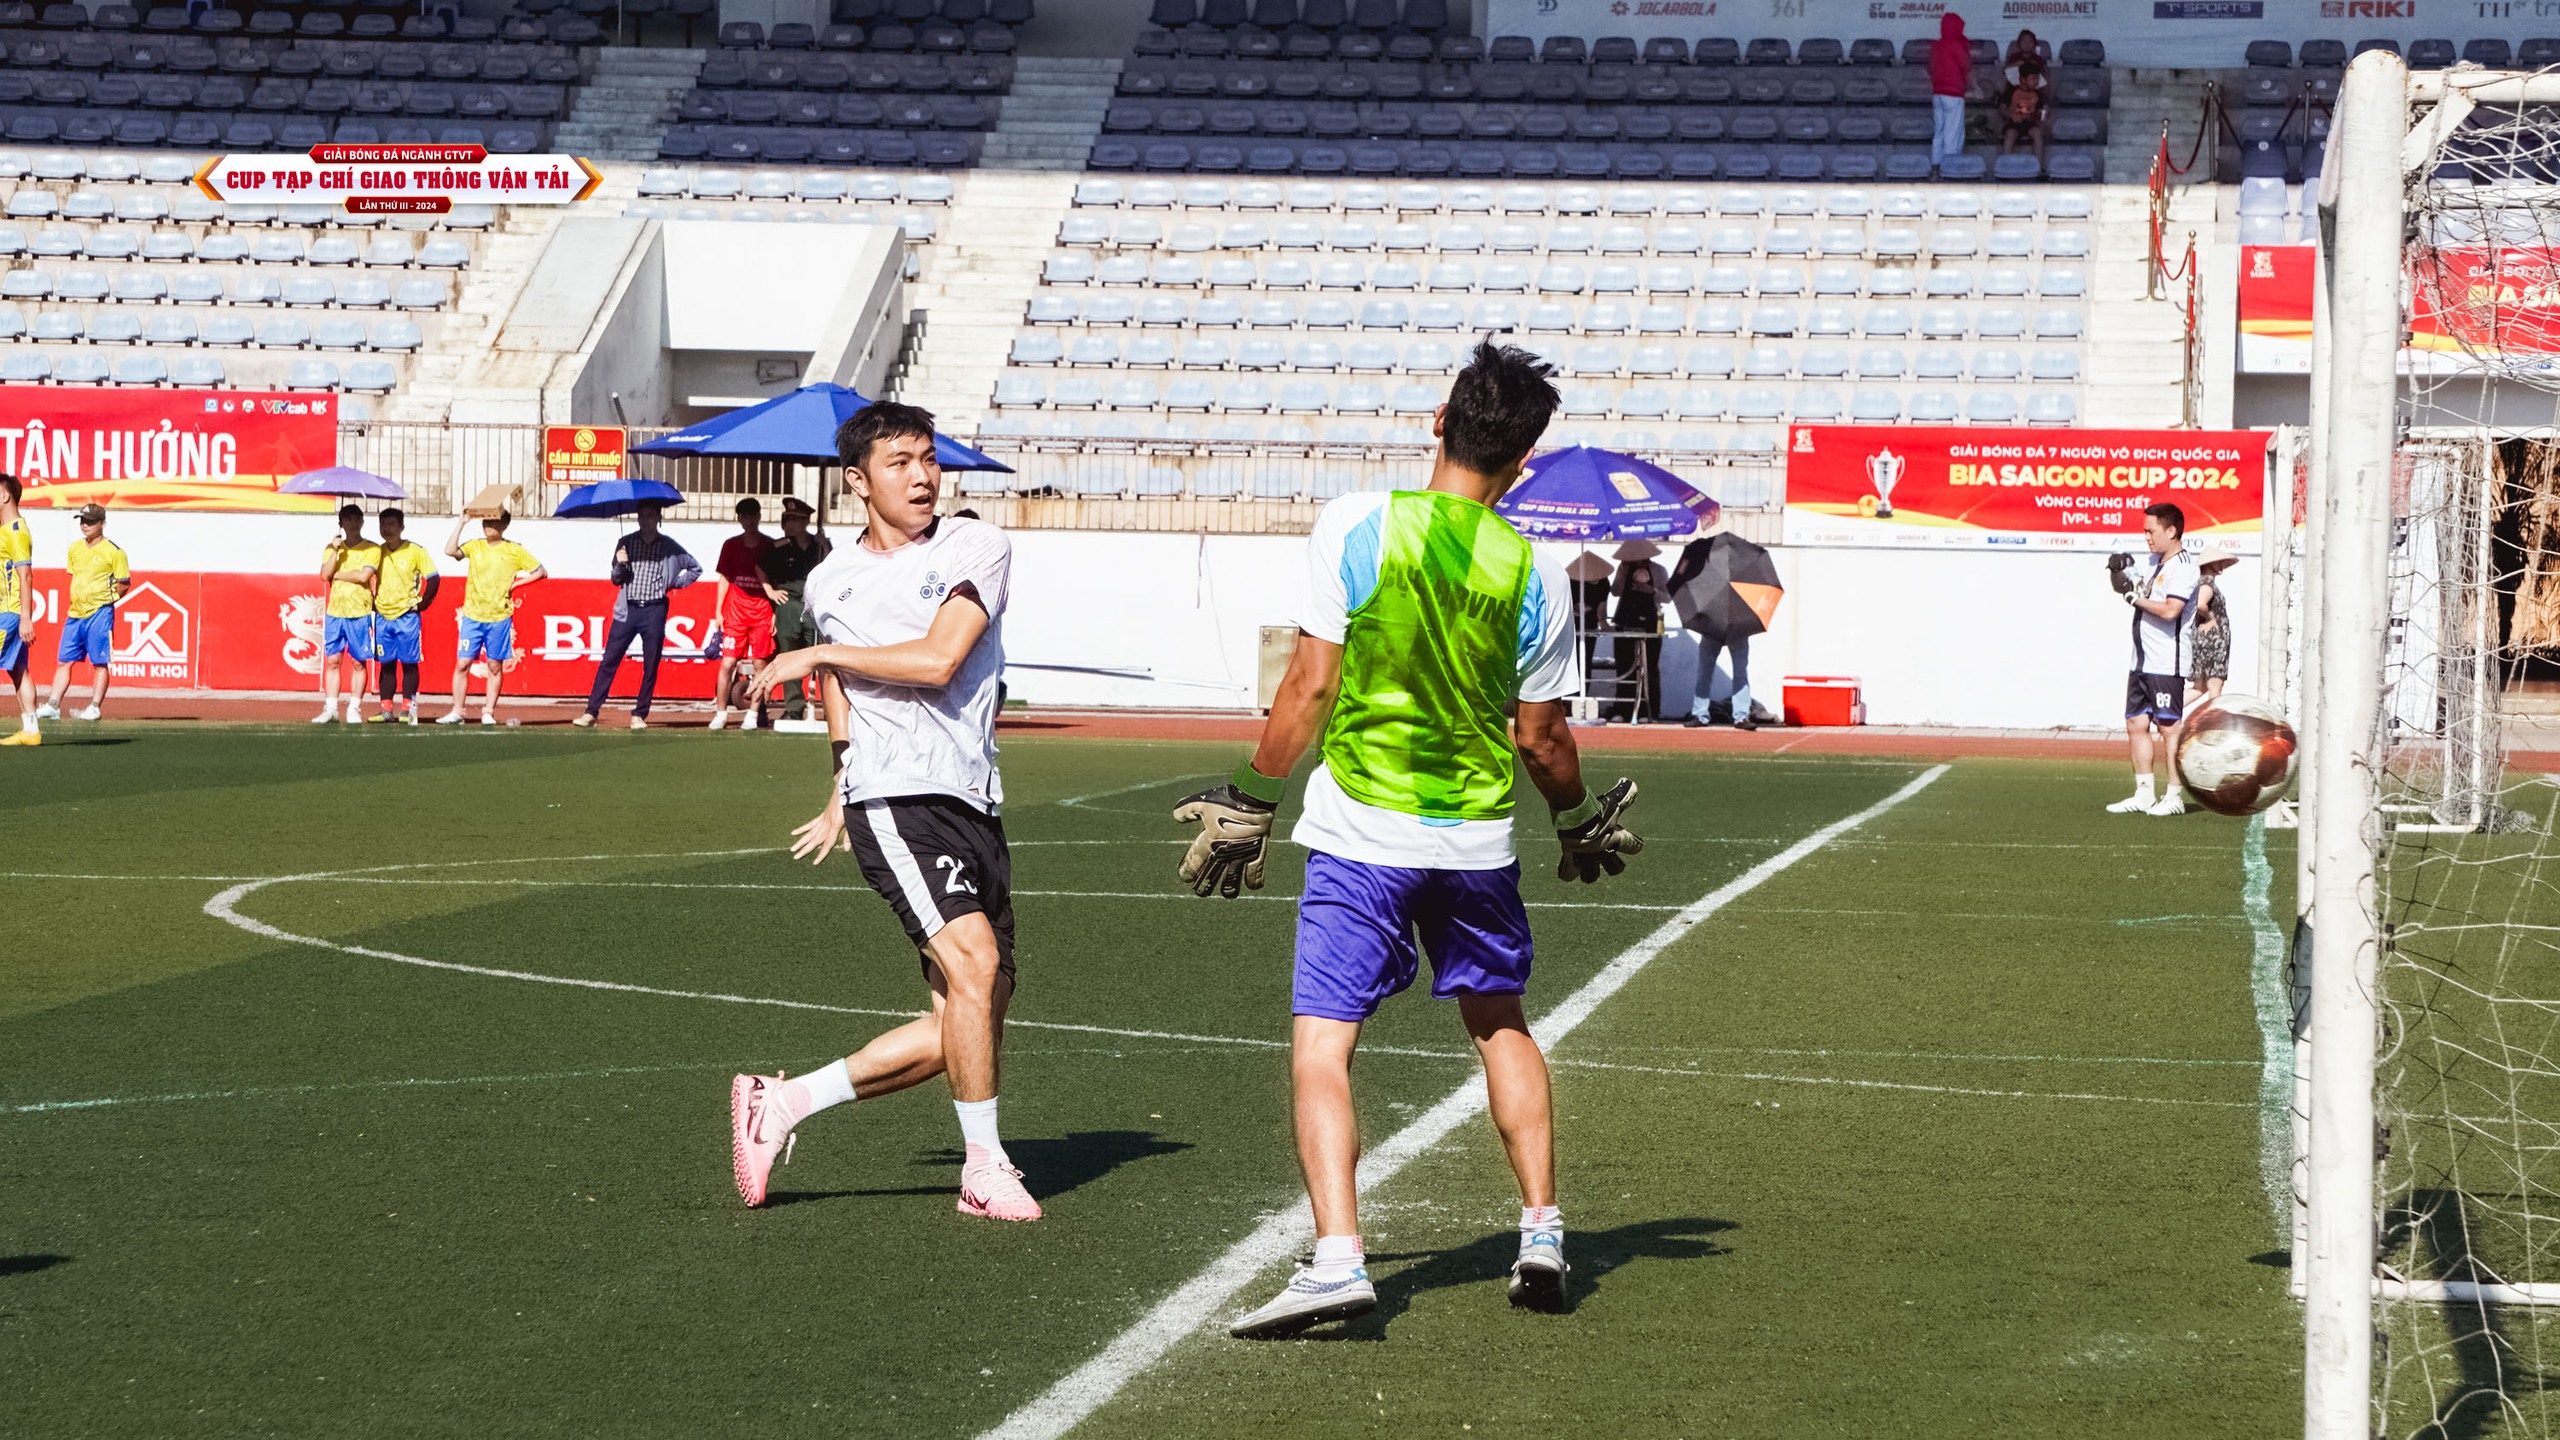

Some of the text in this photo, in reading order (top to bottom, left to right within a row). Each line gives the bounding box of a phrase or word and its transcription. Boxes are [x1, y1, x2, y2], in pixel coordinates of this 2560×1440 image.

[2003, 2, 2097, 14] AOBONGDA.NET
[2348, 1, 2415, 17] RIKI
[0, 419, 237, 486] TẬN HƯỞNG
[548, 448, 621, 466] CẤM HÚT THUỐC
[1949, 443, 2240, 461] GIẢI BÓNG ĐÁ 7 NGƯỜI VÔ ĐỊCH QUỐC GIA
[552, 469, 617, 481] NO SMOKING
[1949, 464, 2240, 489] BIA SAIGON CUP 2024
[2034, 494, 2151, 509] VÒNG CHUNG KẾT
[150, 664, 188, 679] KHOI
